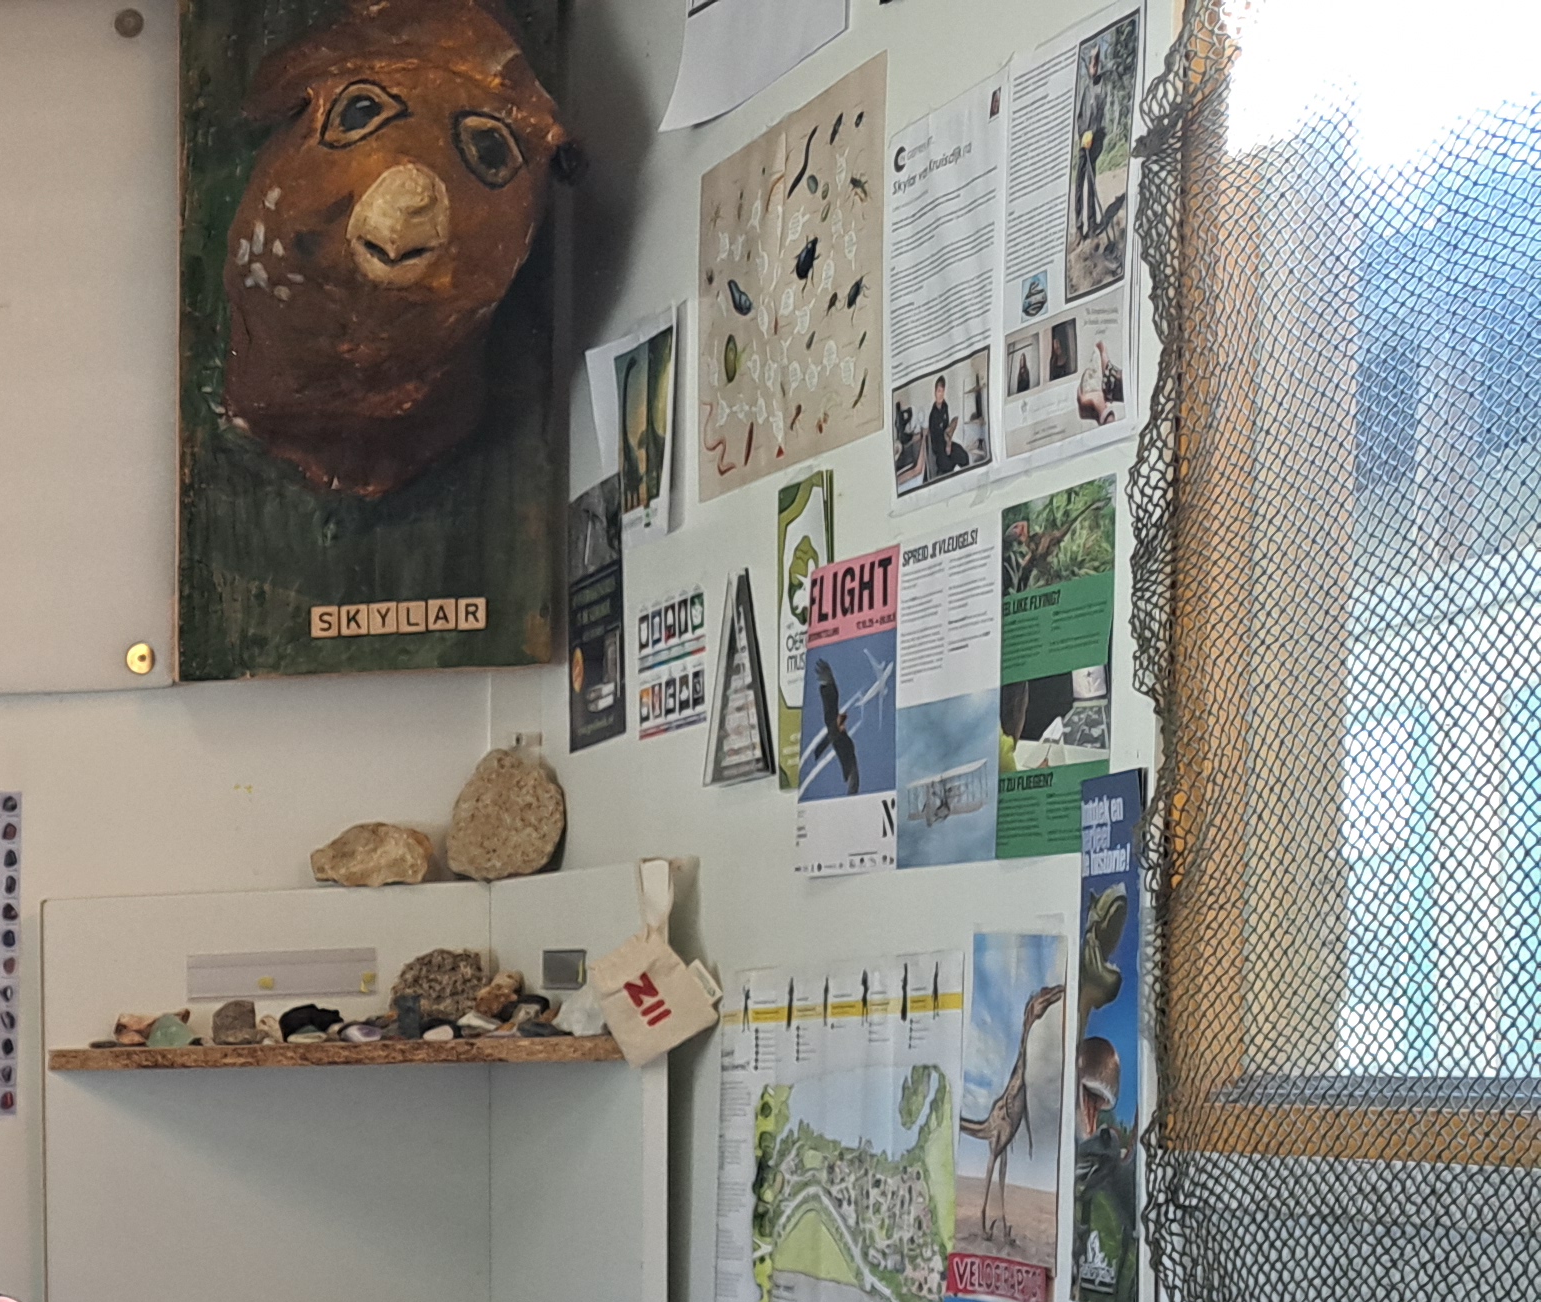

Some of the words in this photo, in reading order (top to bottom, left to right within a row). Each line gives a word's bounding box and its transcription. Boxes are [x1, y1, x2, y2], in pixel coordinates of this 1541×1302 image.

[902, 545, 928, 567] SPREID
[808, 556, 893, 628] FLIGHT
[318, 603, 480, 632] SKYLAR
